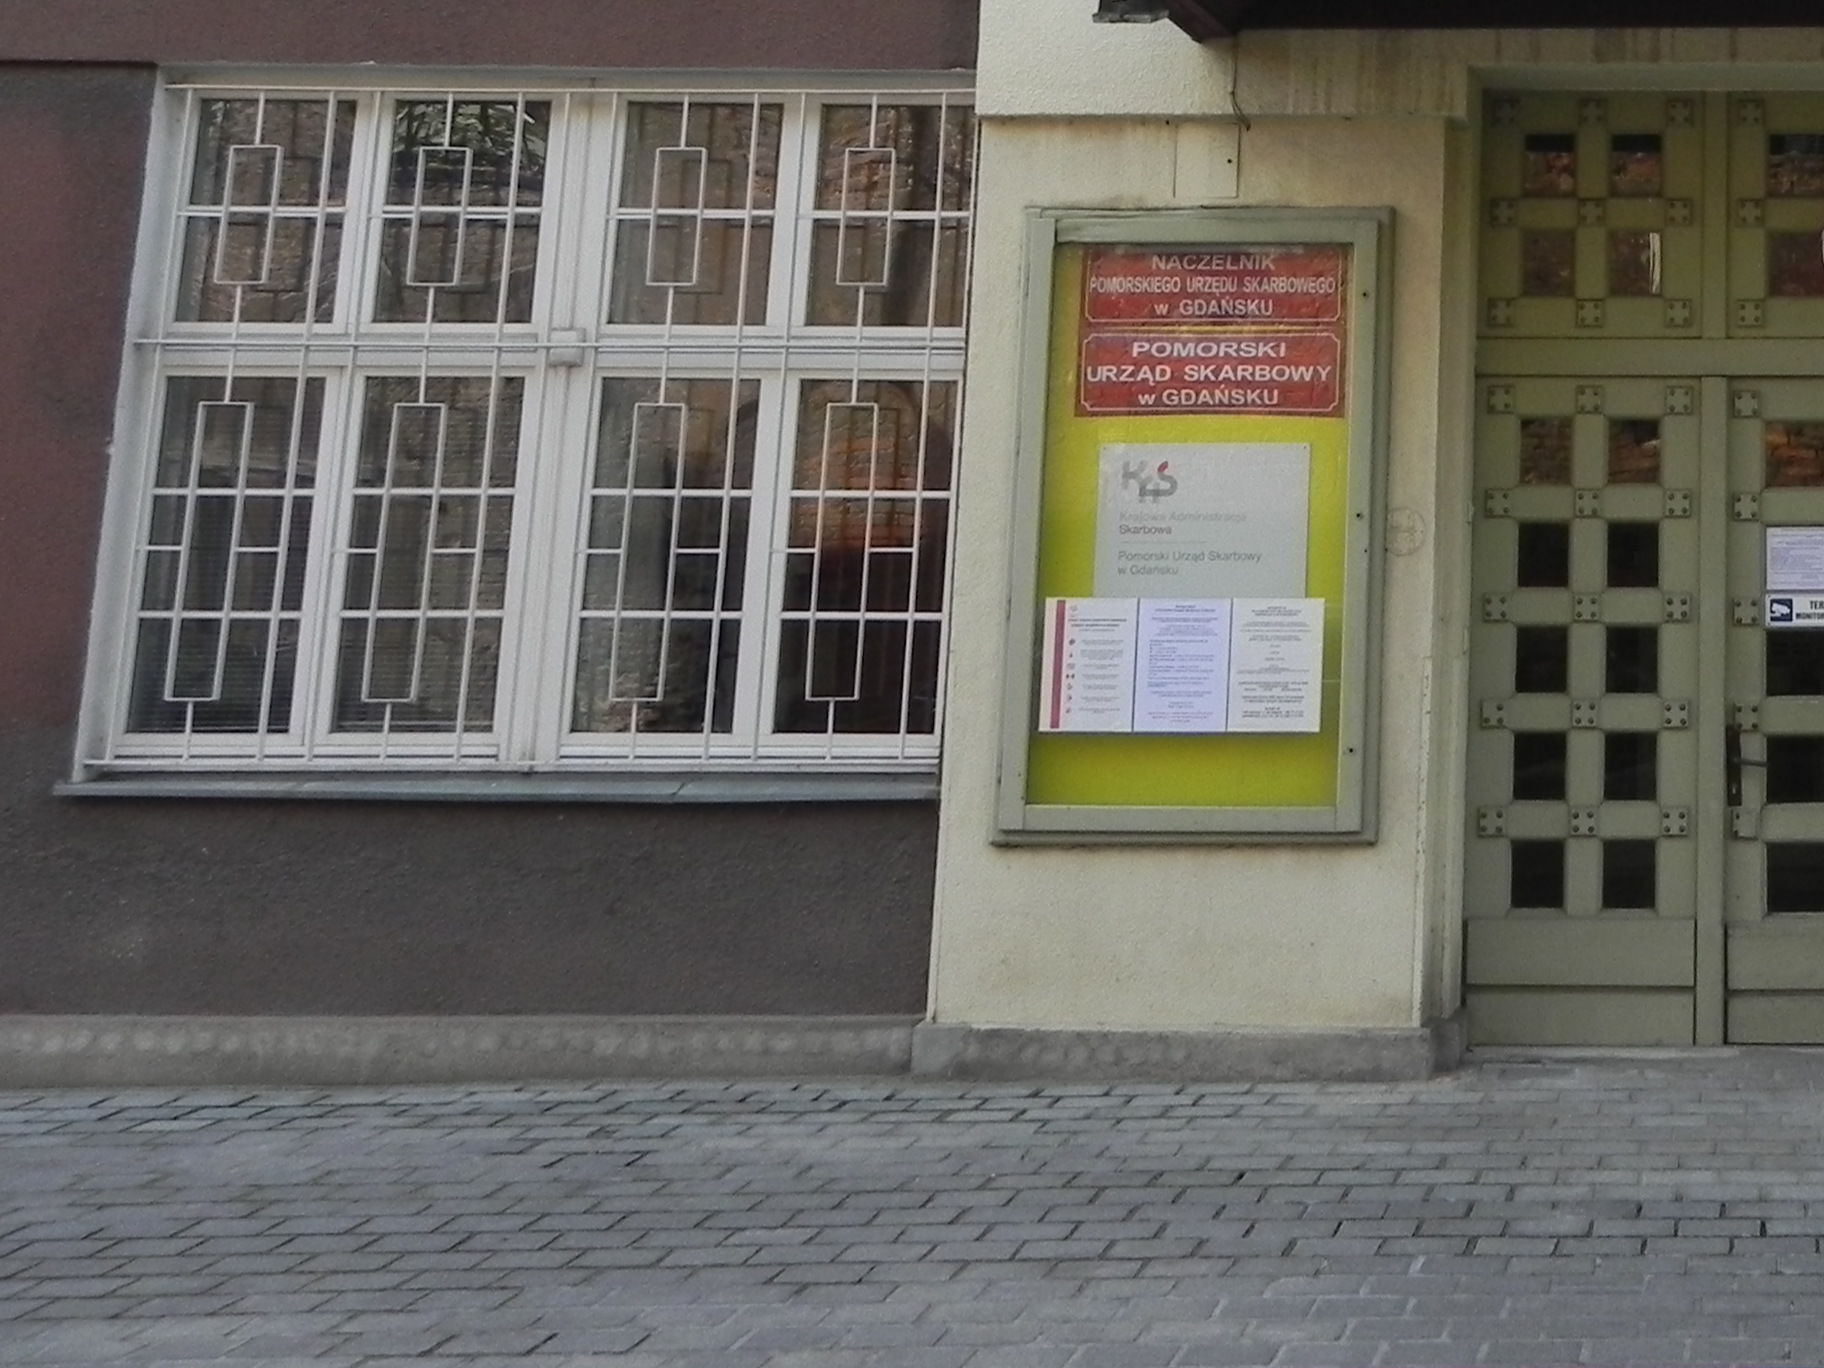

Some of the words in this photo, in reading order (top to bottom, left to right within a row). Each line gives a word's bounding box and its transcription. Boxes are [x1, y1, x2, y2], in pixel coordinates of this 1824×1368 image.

[1151, 253, 1276, 271] NACZELNIK
[1089, 276, 1181, 294] POMORSKIEGO
[1186, 276, 1238, 297] URZĘDU
[1242, 277, 1336, 294] SKARBOWEGO
[1154, 303, 1169, 316] w
[1179, 295, 1274, 317] GDAŃSKU
[1131, 341, 1286, 358] POMORSKI
[1087, 365, 1172, 386] URZĄD
[1184, 364, 1332, 382] SKARBOWY
[1137, 393, 1157, 406] w
[1162, 384, 1279, 406] GDAŃSKU
[1119, 511, 1166, 523] Krajowa
[1169, 511, 1248, 523] Administracja
[1119, 524, 1173, 535] Skarbowa
[1117, 550, 1169, 561] Pomorski
[1172, 550, 1205, 563] Urząd
[1207, 550, 1262, 563] Skarbowy
[1117, 566, 1127, 575] w
[1129, 564, 1180, 575] Gdańsku
